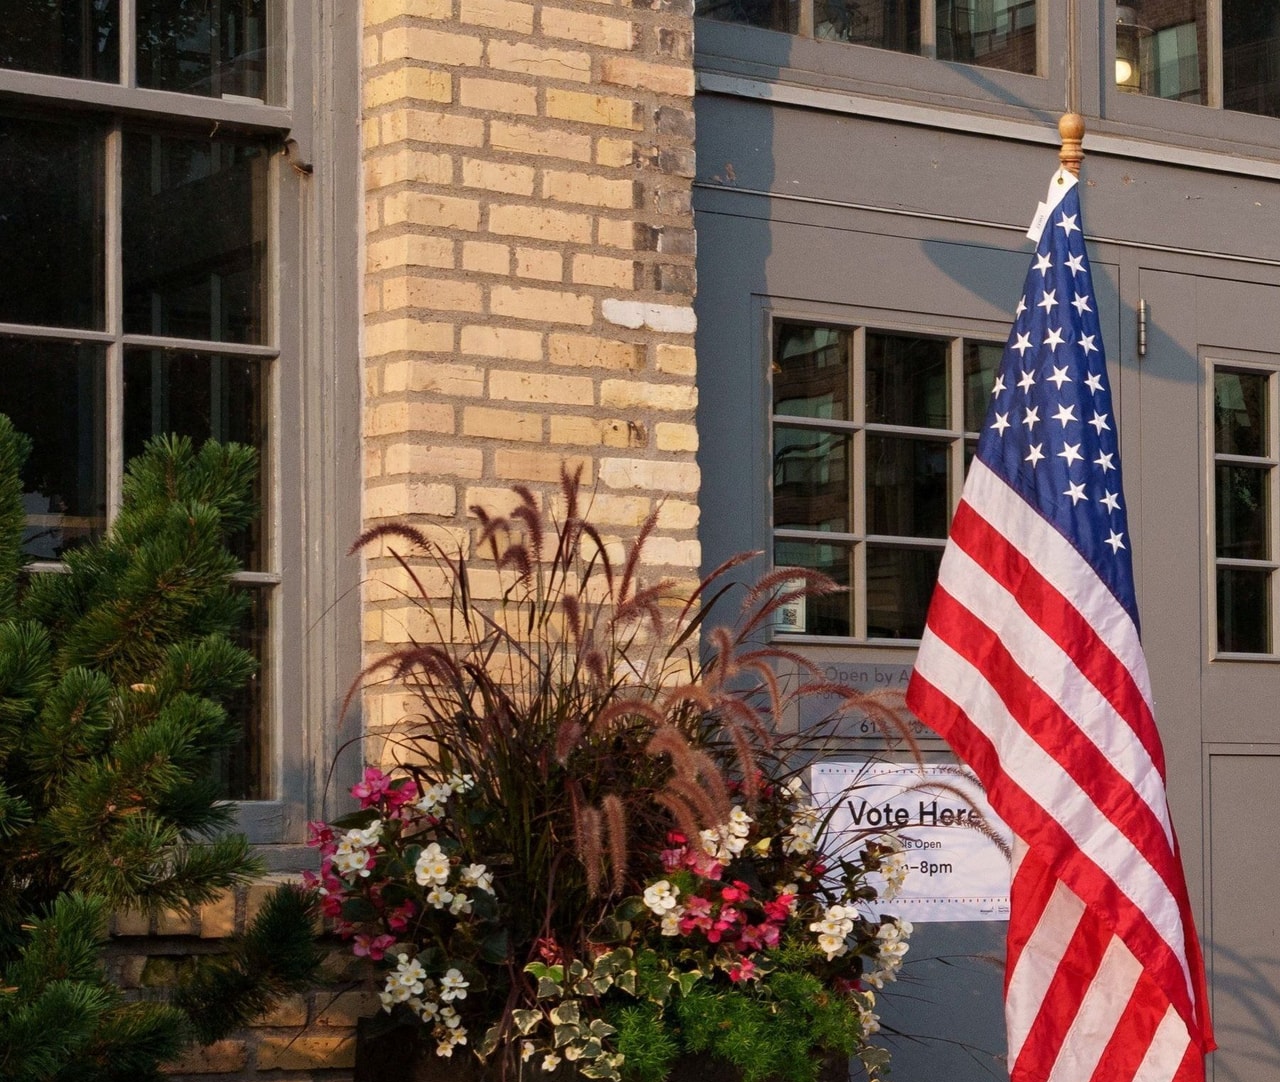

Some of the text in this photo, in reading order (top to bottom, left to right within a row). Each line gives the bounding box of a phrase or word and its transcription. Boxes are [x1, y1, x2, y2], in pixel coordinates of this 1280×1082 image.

[826, 666, 868, 685] Open
[874, 666, 893, 687] by
[847, 800, 981, 826] Vote Here
[914, 838, 942, 850] Open
